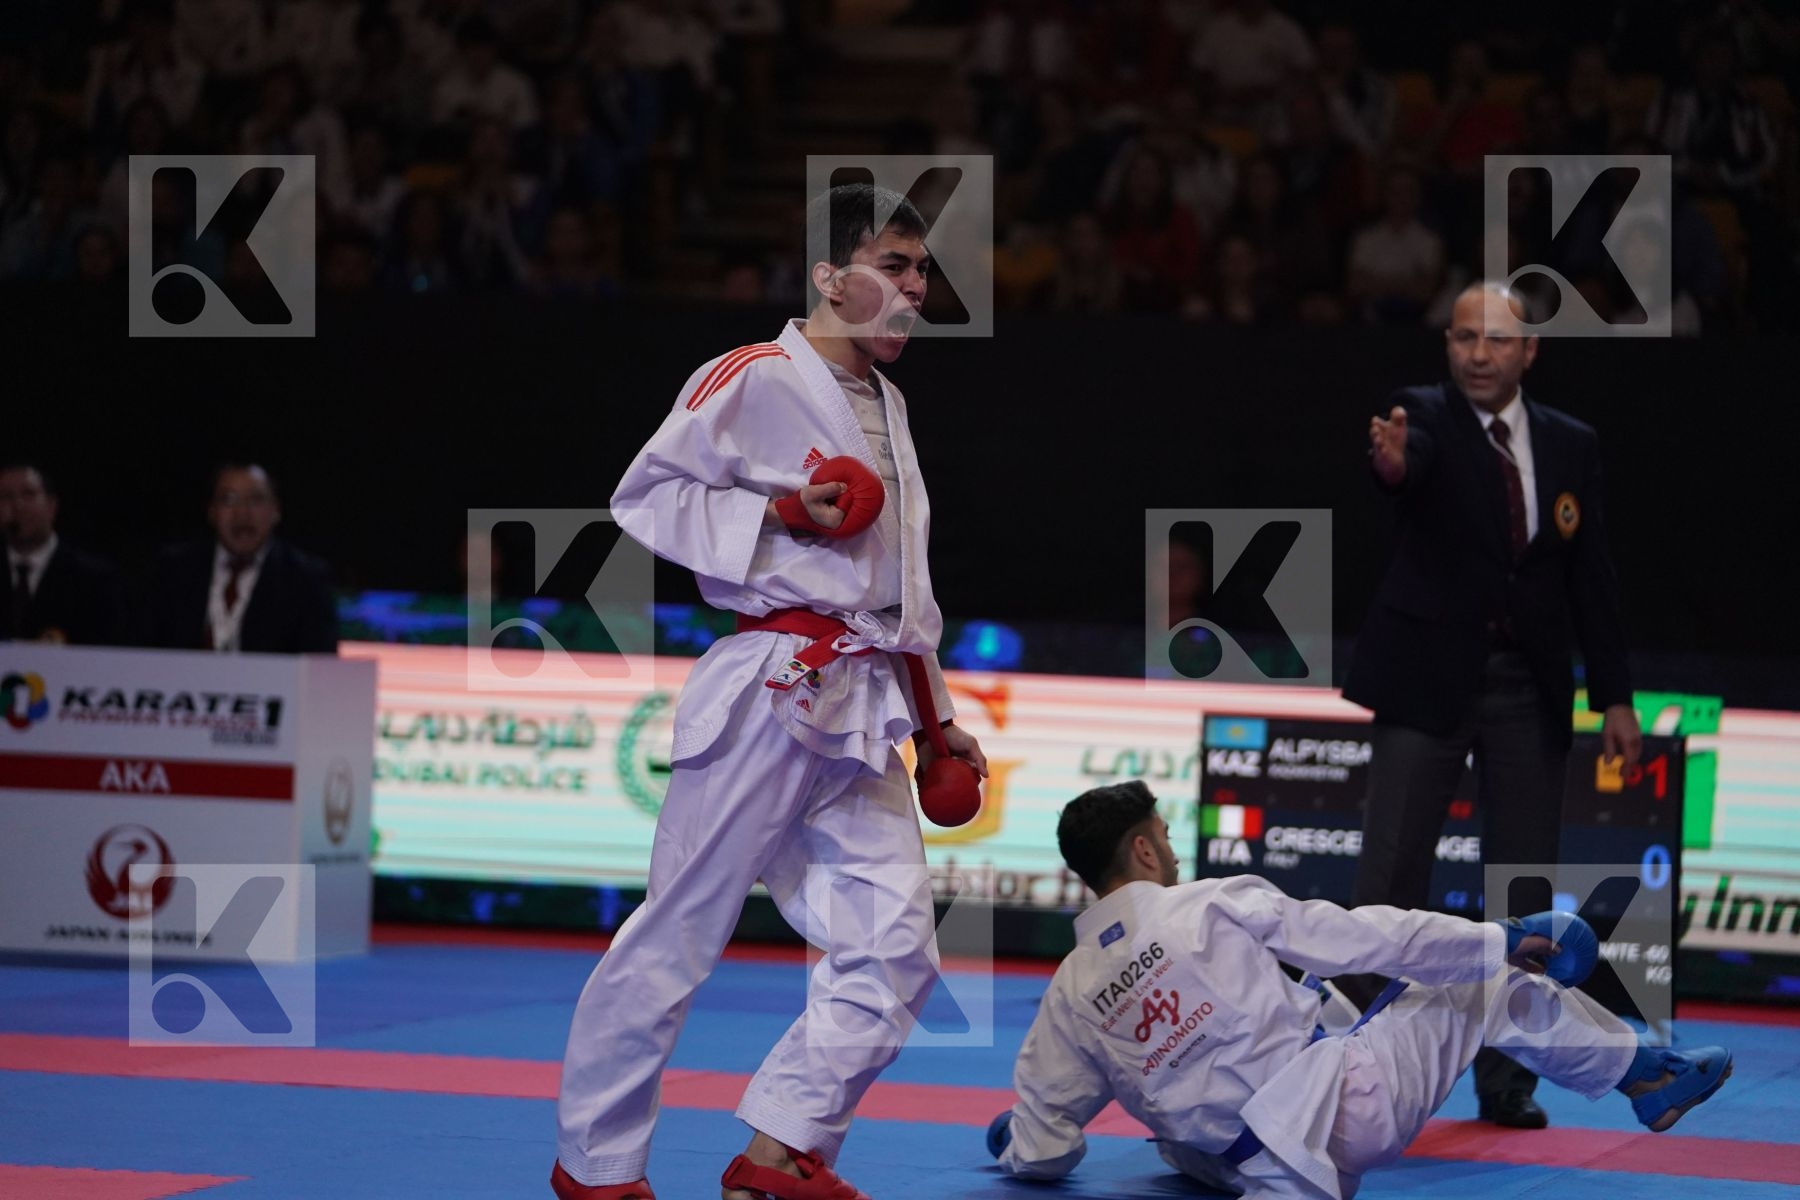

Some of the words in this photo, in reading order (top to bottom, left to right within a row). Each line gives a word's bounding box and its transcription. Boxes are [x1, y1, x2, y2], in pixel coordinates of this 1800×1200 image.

[99, 761, 172, 793] AKA
[477, 763, 588, 790] POLICE
[1207, 749, 1264, 778] KAZ
[1208, 838, 1254, 866] ITA
[1641, 844, 1672, 891] 0
[1092, 942, 1165, 1016] ITA0266
